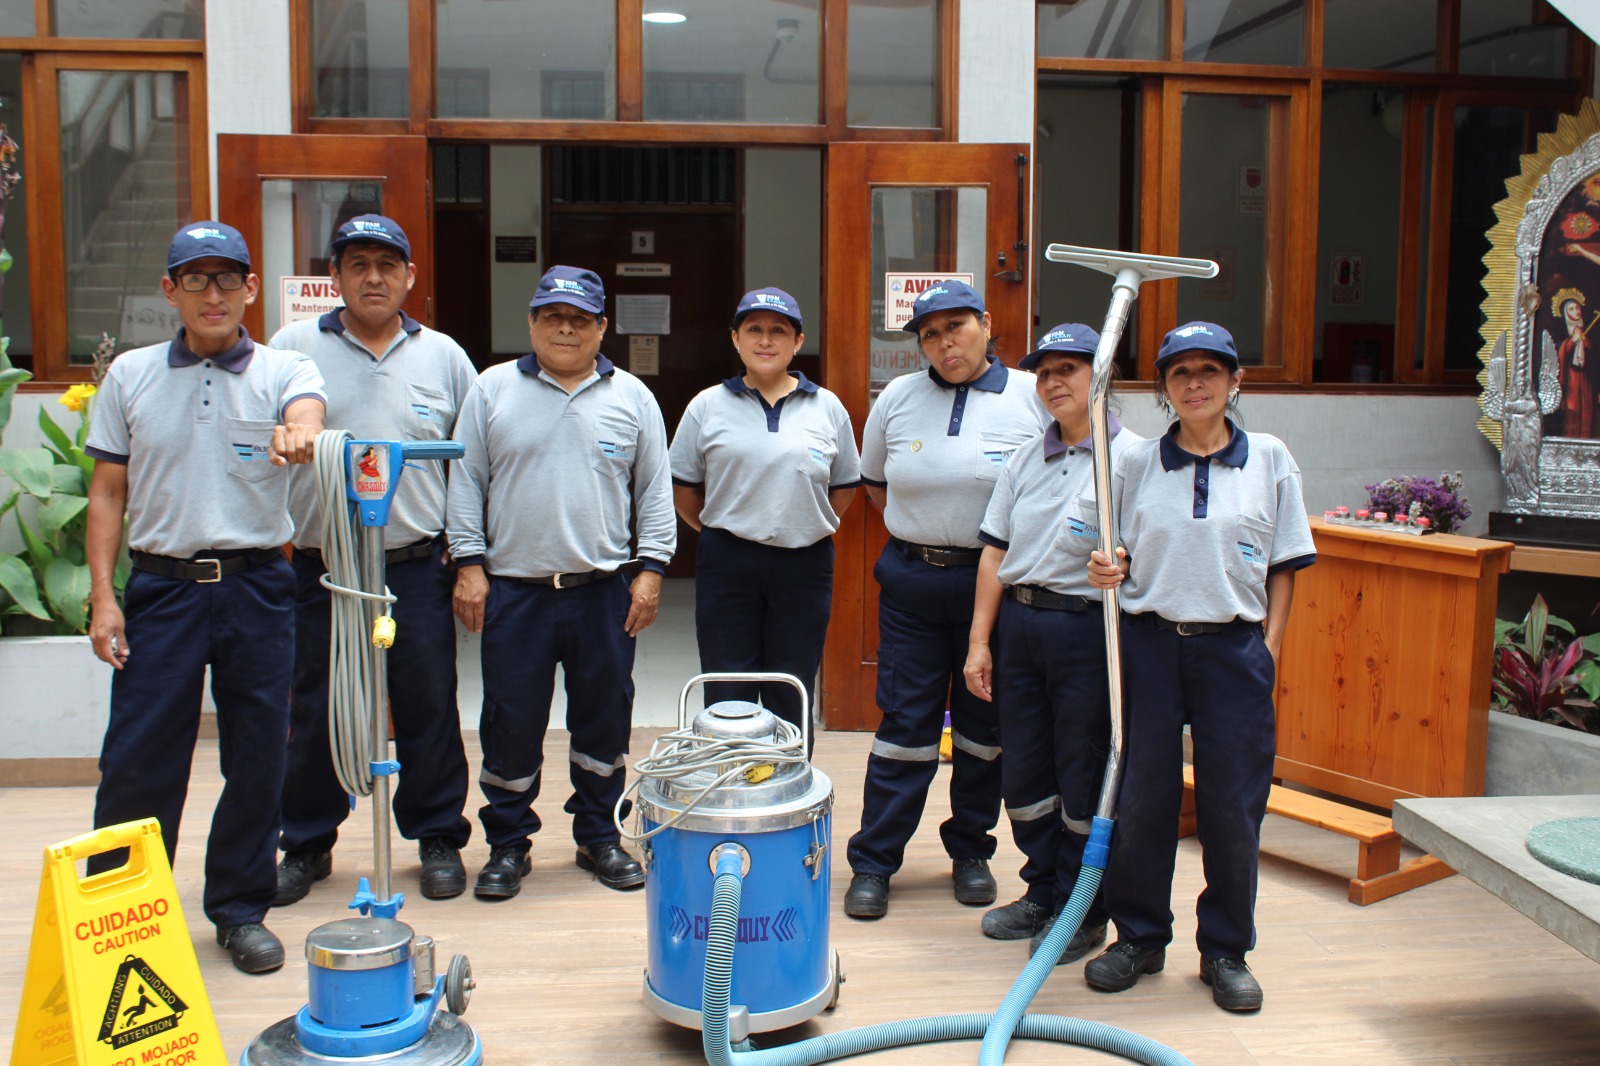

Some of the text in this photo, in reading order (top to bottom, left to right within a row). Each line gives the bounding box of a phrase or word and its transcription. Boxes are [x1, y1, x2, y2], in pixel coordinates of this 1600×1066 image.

[639, 236, 647, 248] 5
[301, 283, 341, 297] AVIS
[292, 304, 334, 312] Mantene
[75, 898, 169, 941] CUIDADO
[93, 923, 162, 955] CAUTION
[104, 974, 127, 1029] ACHTUNG
[140, 966, 176, 1005] CUIDADO
[117, 1018, 173, 1046] ATTENTION
[141, 1032, 199, 1064] MOJADO
